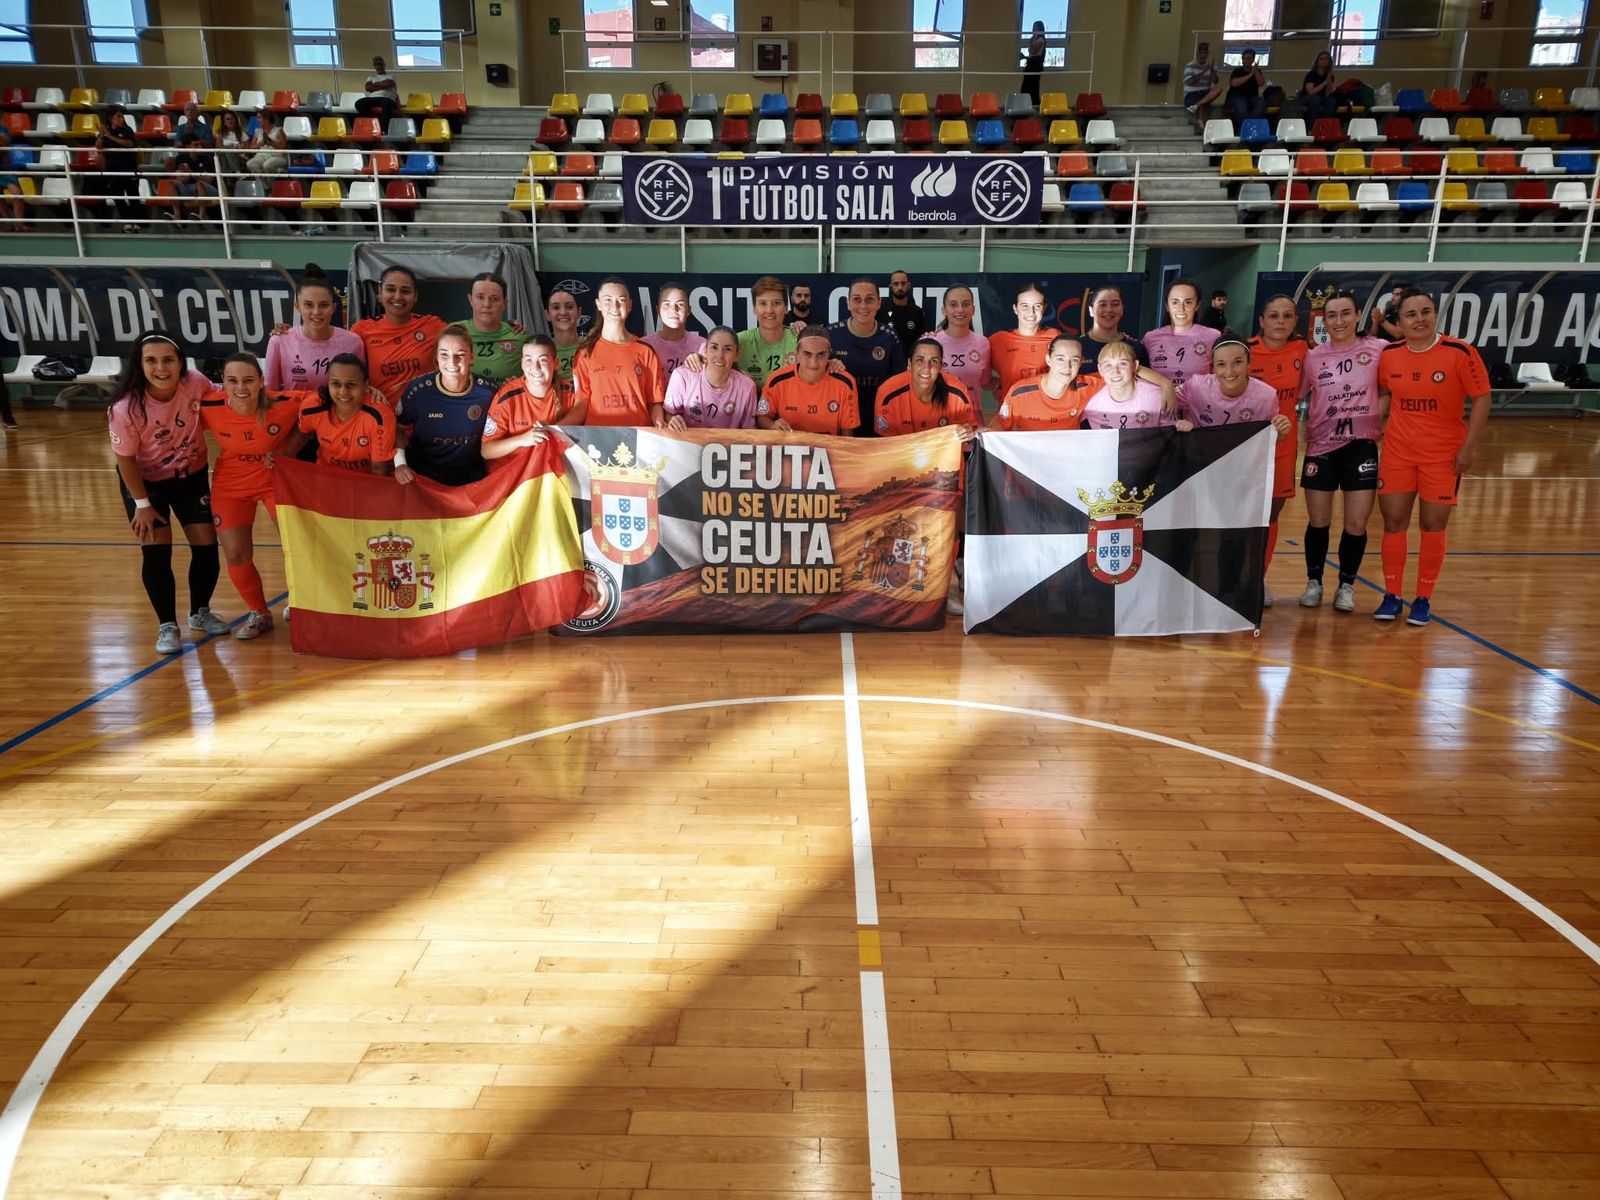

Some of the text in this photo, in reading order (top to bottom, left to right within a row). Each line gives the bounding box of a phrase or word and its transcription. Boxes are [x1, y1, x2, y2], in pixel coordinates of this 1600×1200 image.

[740, 161, 894, 180] DIVISIÓN
[739, 179, 895, 221] FÚTBOL SALA
[908, 210, 957, 221] Iberdrola
[177, 288, 301, 344] CEUT
[477, 341, 494, 357] 23
[312, 357, 329, 375] 19
[766, 354, 781, 371] 13
[951, 354, 966, 367] 25
[1336, 358, 1353, 376] 10
[807, 404, 818, 415] 20
[1400, 398, 1438, 412] CEUTA
[175, 410, 186, 427] 6
[701, 443, 836, 491] CEUTA
[702, 491, 847, 522] NO SE VENDE,
[702, 519, 834, 565] CEUTA
[701, 566, 842, 594] SE DEFIENDE
